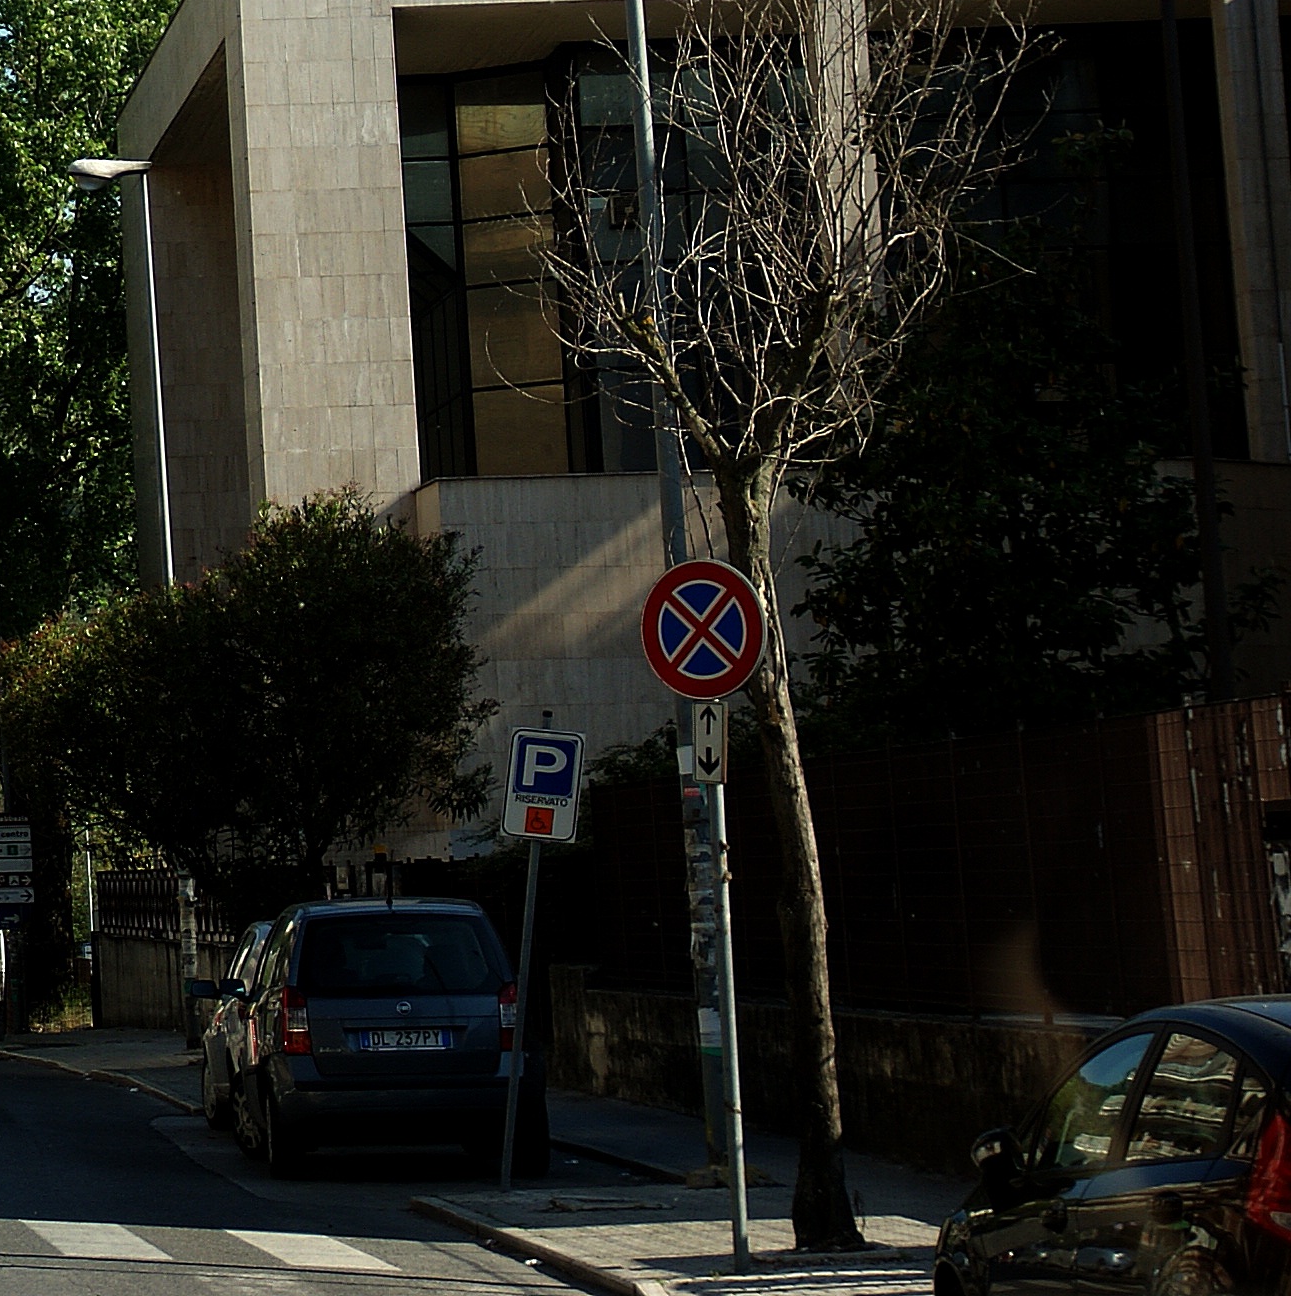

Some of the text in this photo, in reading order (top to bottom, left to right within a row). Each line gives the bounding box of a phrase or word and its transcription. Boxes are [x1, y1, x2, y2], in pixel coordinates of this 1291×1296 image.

[522, 744, 567, 786] P
[515, 794, 568, 807] RISERVATO
[371, 1030, 440, 1046] DL 237PY
